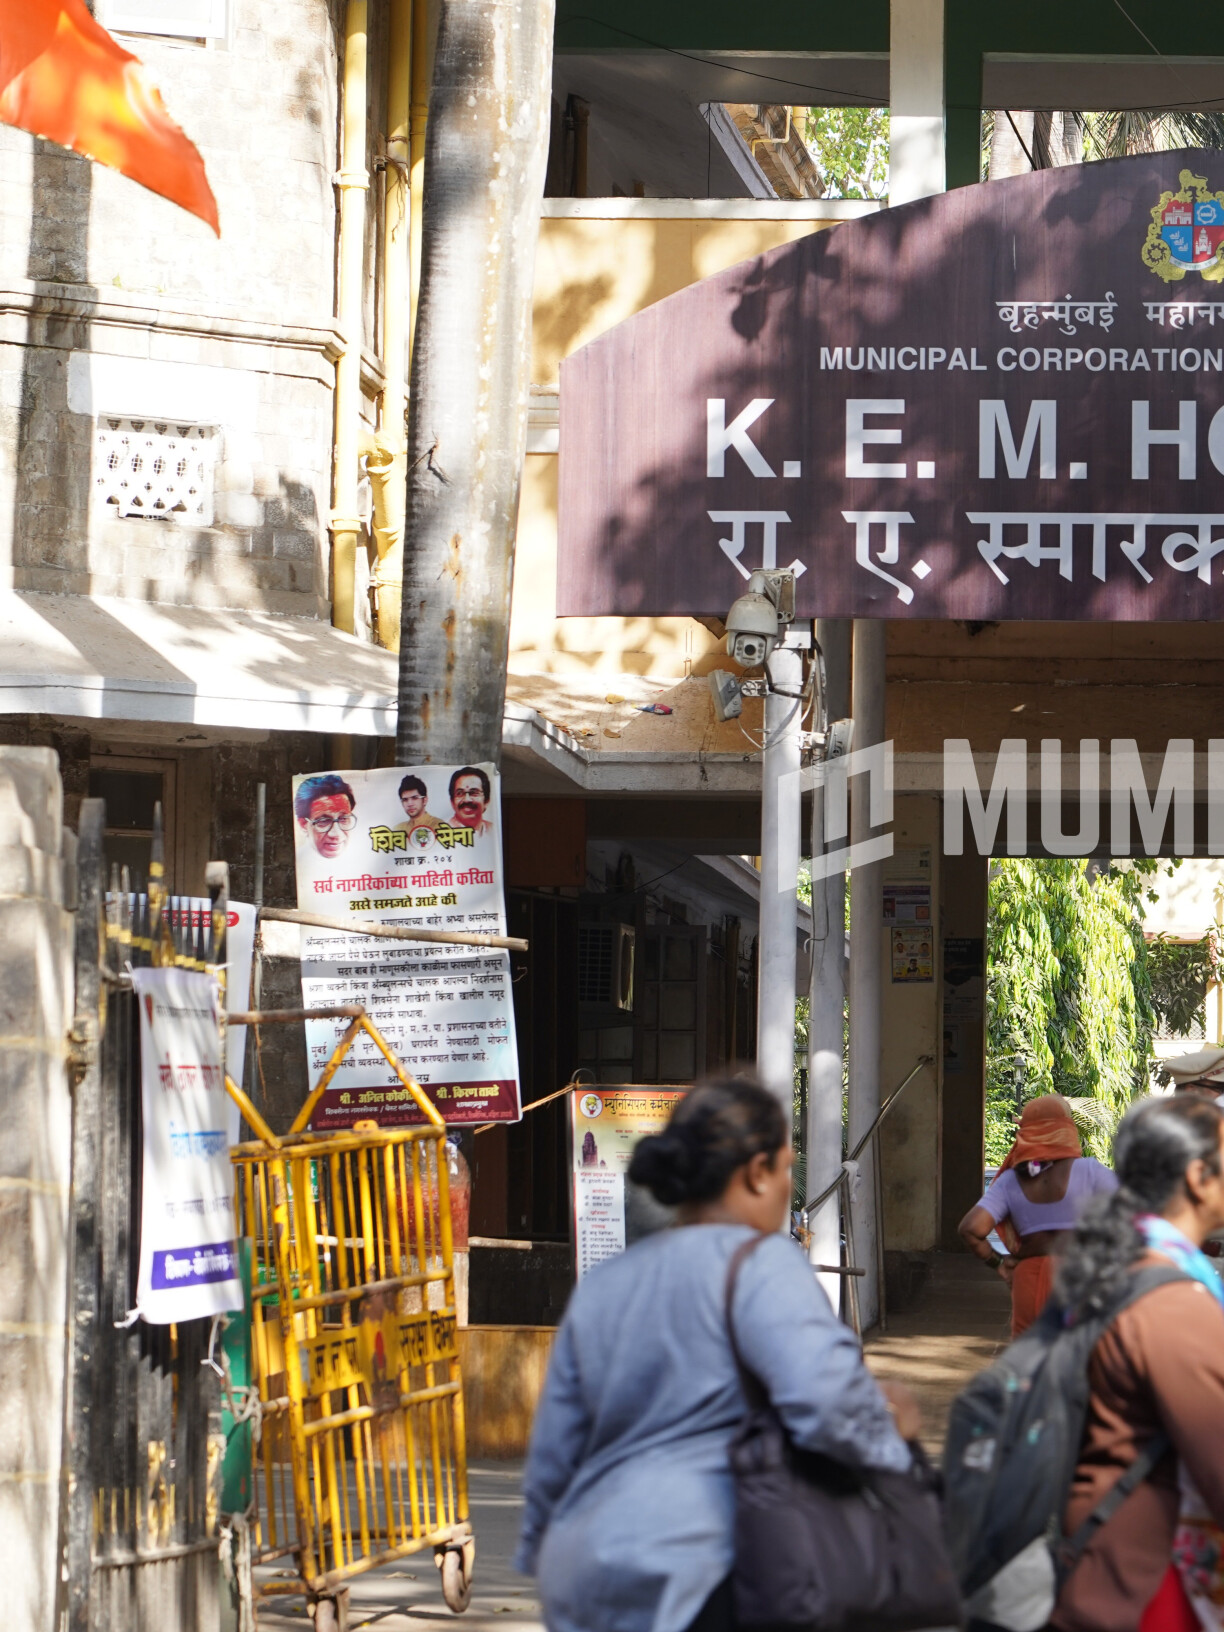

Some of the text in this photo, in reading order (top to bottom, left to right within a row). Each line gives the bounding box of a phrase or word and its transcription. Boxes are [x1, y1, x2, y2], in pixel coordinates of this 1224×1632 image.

[996, 291, 1118, 336] बृहन्मुंबई
[819, 346, 988, 371] MUNICIPAL
[997, 347, 1223, 372] CORPORATION
[706, 398, 801, 478] K.
[844, 398, 936, 479] E.
[979, 399, 1088, 480] M.
[707, 510, 808, 581] रा.
[840, 510, 935, 606] ए.
[370, 823, 475, 853] शिव सेना
[394, 855, 452, 866] शाखा क्र. २०४
[313, 868, 494, 894] सर्व नागरिकांच्या माहिती करिता
[349, 893, 458, 911] असे समजते आहे की
[337, 968, 352, 977] सदर
[354, 966, 368, 976] बाब
[369, 962, 377, 976] ही
[484, 959, 503, 971] असून
[416, 977, 440, 987] चालक
[371, 993, 400, 1006] शिवसेना
[459, 988, 484, 1000] खालील
[488, 989, 505, 1002] नमूद
